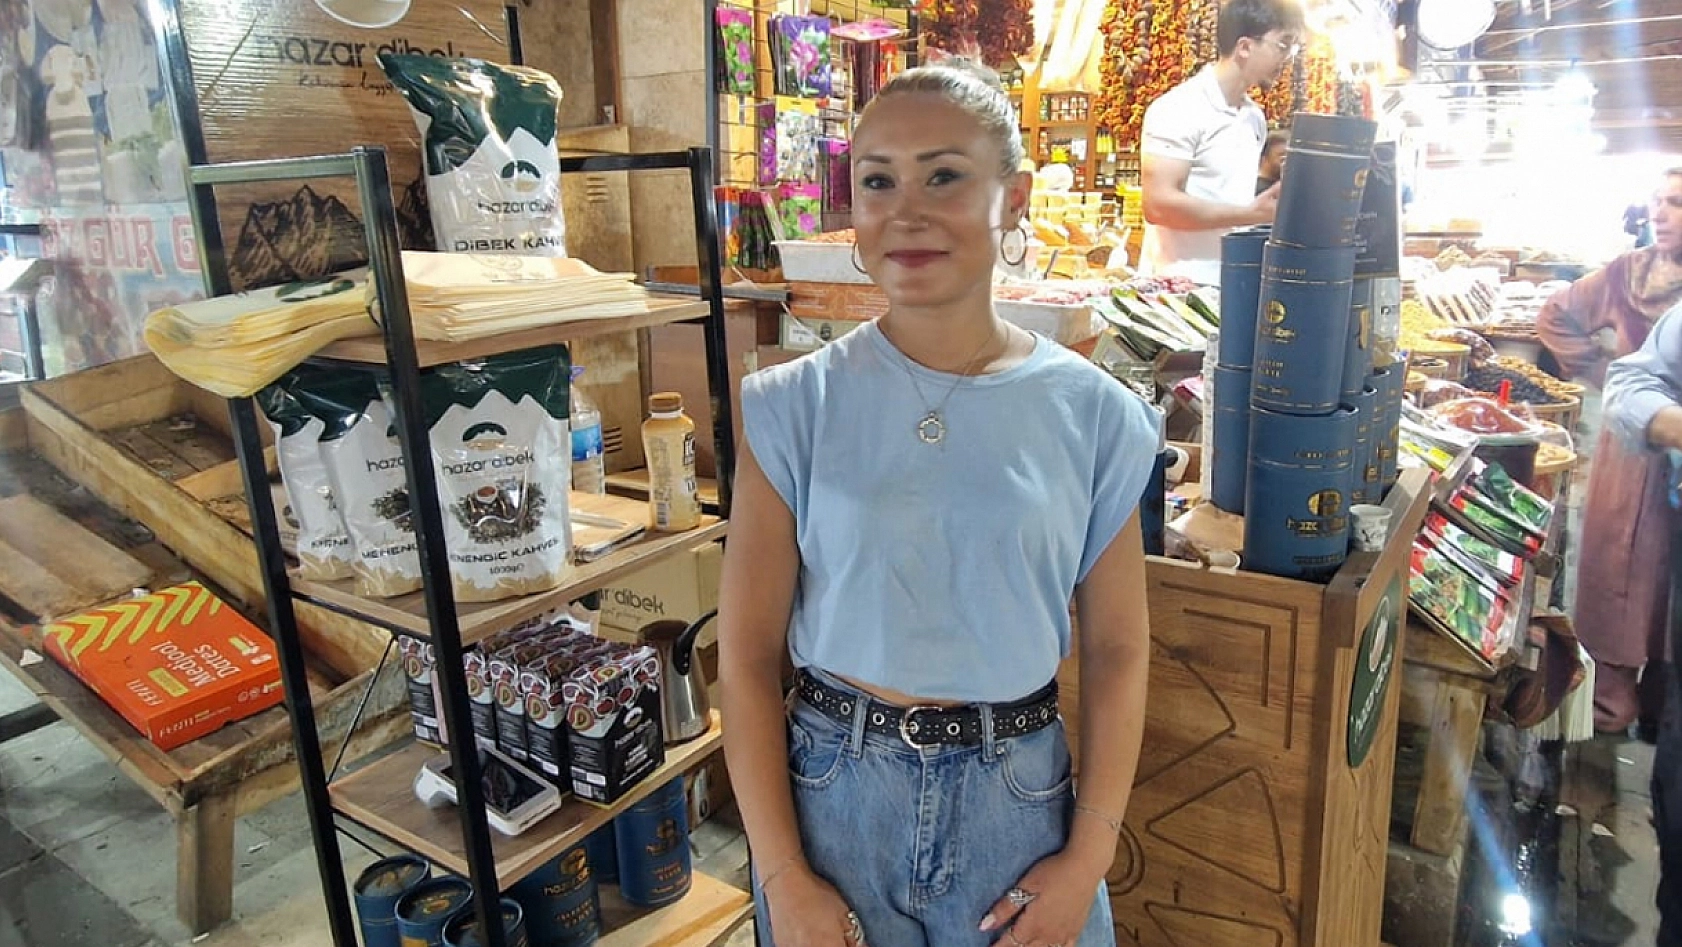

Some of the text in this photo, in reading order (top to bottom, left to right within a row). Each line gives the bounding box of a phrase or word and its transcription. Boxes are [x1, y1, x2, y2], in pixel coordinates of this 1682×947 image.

[614, 588, 665, 615] dibek
[150, 640, 217, 687] Medjool
[193, 644, 241, 678] Dates
